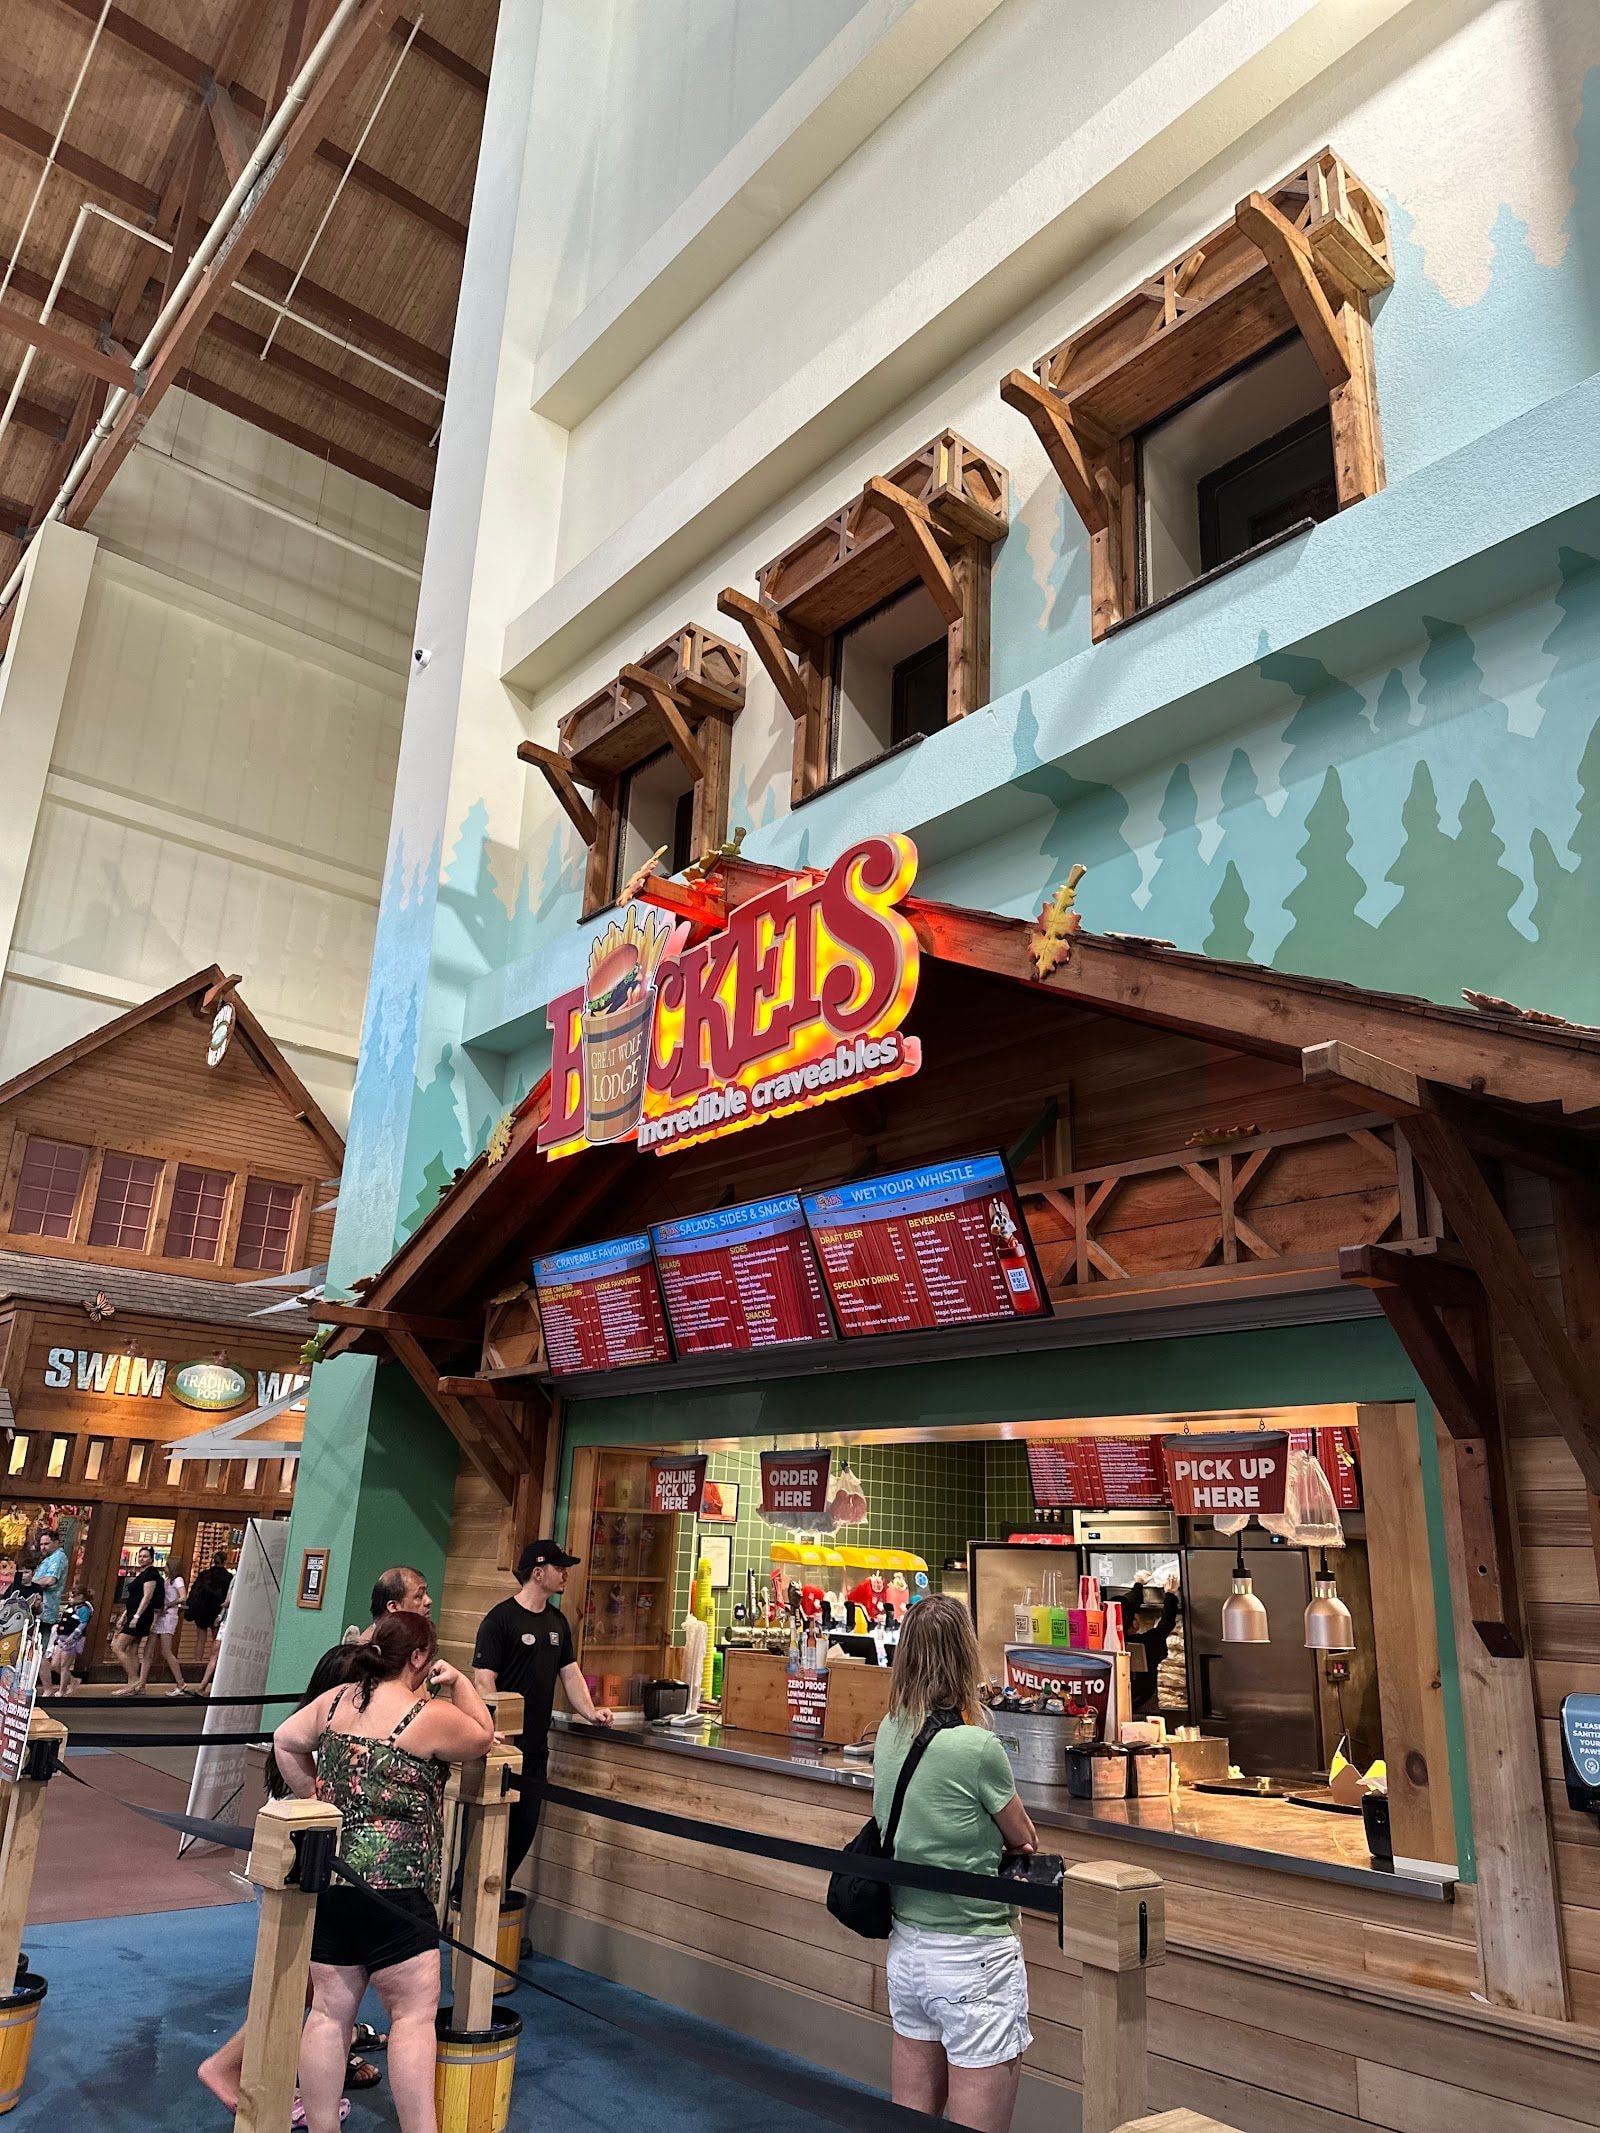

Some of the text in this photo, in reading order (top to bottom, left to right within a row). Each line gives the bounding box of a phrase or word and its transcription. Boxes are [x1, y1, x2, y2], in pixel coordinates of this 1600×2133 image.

[538, 839, 898, 1146] BCKETS
[591, 1031, 643, 1070] GREAT WOLF
[593, 1055, 641, 1102] LODGE
[639, 1034, 898, 1144] incredible craveables
[851, 1186, 877, 1202] WET
[878, 1179, 915, 1196] YOUR
[916, 1165, 975, 1188] WHISTLE
[679, 1219, 718, 1235] SALADS,
[720, 1210, 748, 1226] SIDES
[750, 1208, 758, 1219] &
[759, 1198, 800, 1216] SNACKS
[908, 1211, 956, 1228] BEVERAGES
[820, 1229, 864, 1245] DRAFT BEER
[556, 1250, 597, 1269] CRAVEABLE
[598, 1239, 646, 1259] FAVOURITES
[730, 1245, 747, 1254] SIDES
[833, 1273, 899, 1291] SPECIALTY DRINKS
[745, 1309, 771, 1320] SNACKS
[45, 1346, 167, 1398] SWIM
[183, 1374, 241, 1392] TRADING
[197, 1388, 223, 1400] POST
[657, 1470, 695, 1484] ONLINE
[769, 1470, 818, 1486] ORDER
[1175, 1458, 1276, 1481] PICK UP
[655, 1483, 696, 1497] PICK UP
[1193, 1486, 1260, 1508] HERE
[661, 1497, 689, 1510] HERE
[774, 1491, 811, 1507] HERE
[788, 1680, 827, 1691] ZERO PROOF
[1085, 1679, 1105, 1695] TO
[792, 1715, 821, 1725] AVAILABLE
